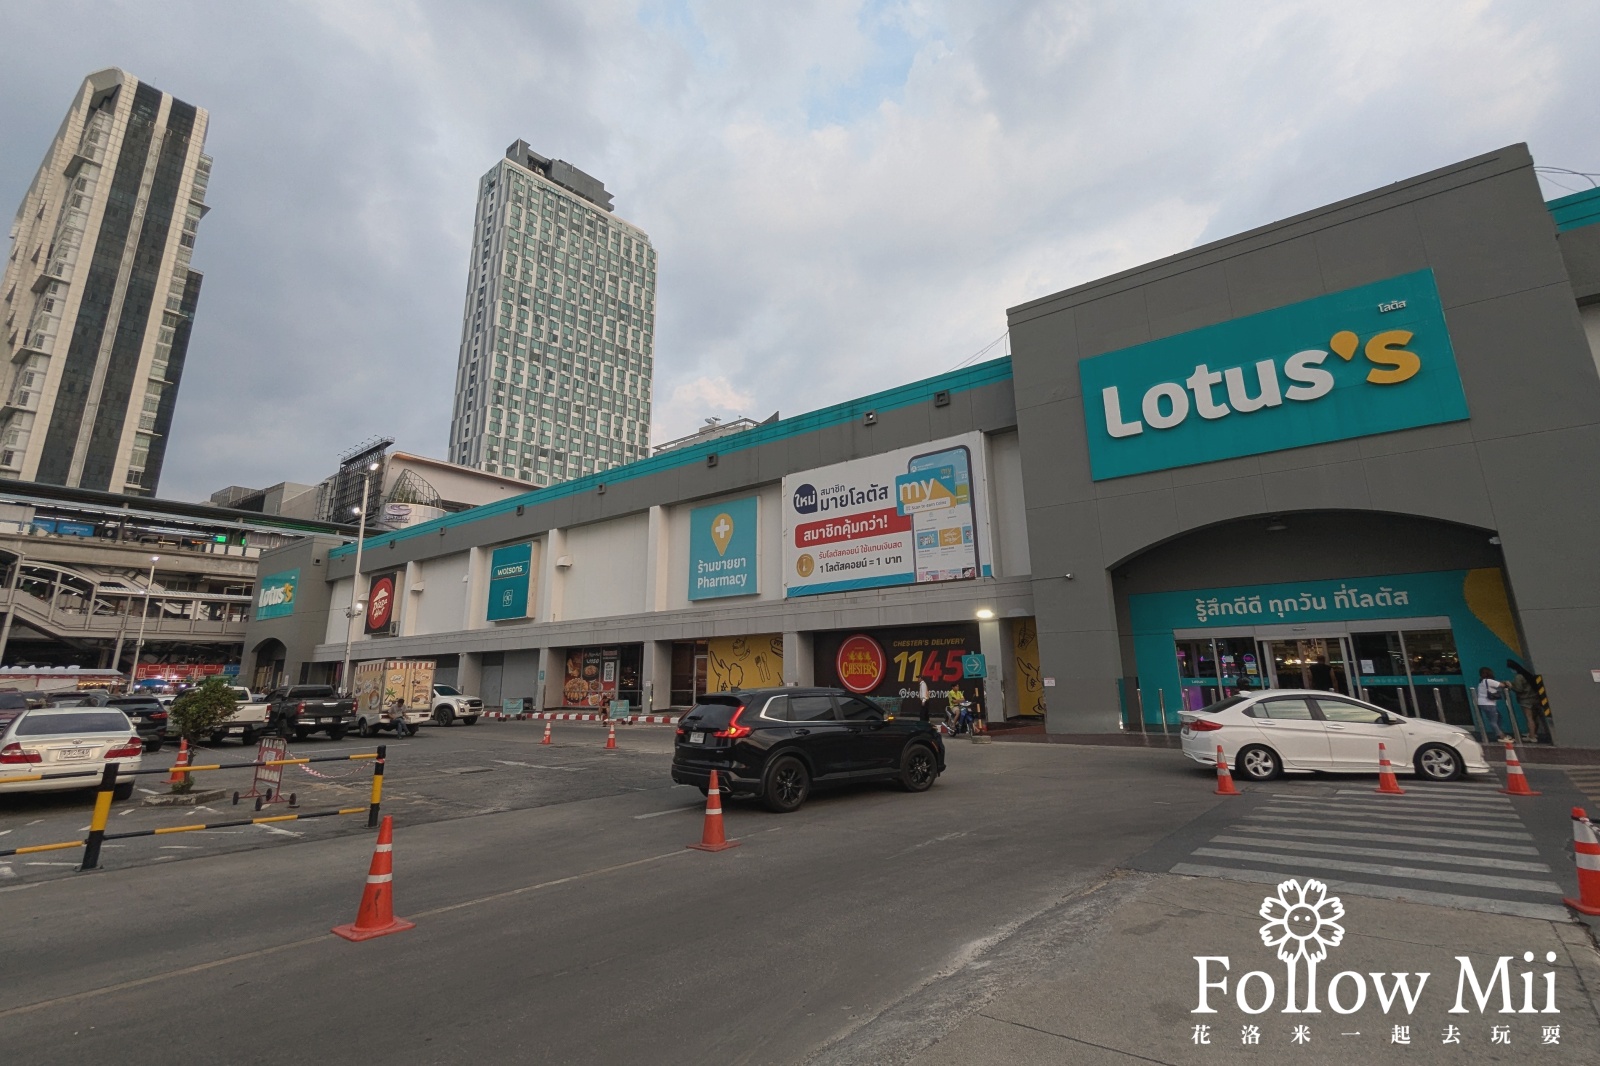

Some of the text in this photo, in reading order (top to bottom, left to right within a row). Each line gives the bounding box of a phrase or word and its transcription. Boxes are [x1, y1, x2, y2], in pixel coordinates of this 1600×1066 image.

[1378, 300, 1406, 313] โลตัส
[1102, 329, 1421, 438] Lotus's
[820, 484, 845, 496] สมาชิก
[820, 484, 889, 512] มายโลตัส
[899, 477, 935, 501] my
[794, 490, 816, 508] ใหม่
[803, 514, 888, 541] สมาชิกคุ้มกว่า!
[697, 557, 746, 573] ร้านขายยา
[885, 555, 902, 565] บาท
[497, 565, 523, 576] watsons
[697, 573, 748, 589] Pharmacy
[258, 583, 294, 608] Lotus's
[1195, 584, 1409, 622] รู้สึกดีดี ทุกวัน ที่โลตัส
[893, 637, 966, 648] CHESTER'S DELIVERY
[842, 660, 878, 678] CHESTER'S
[893, 649, 966, 682] 1145
